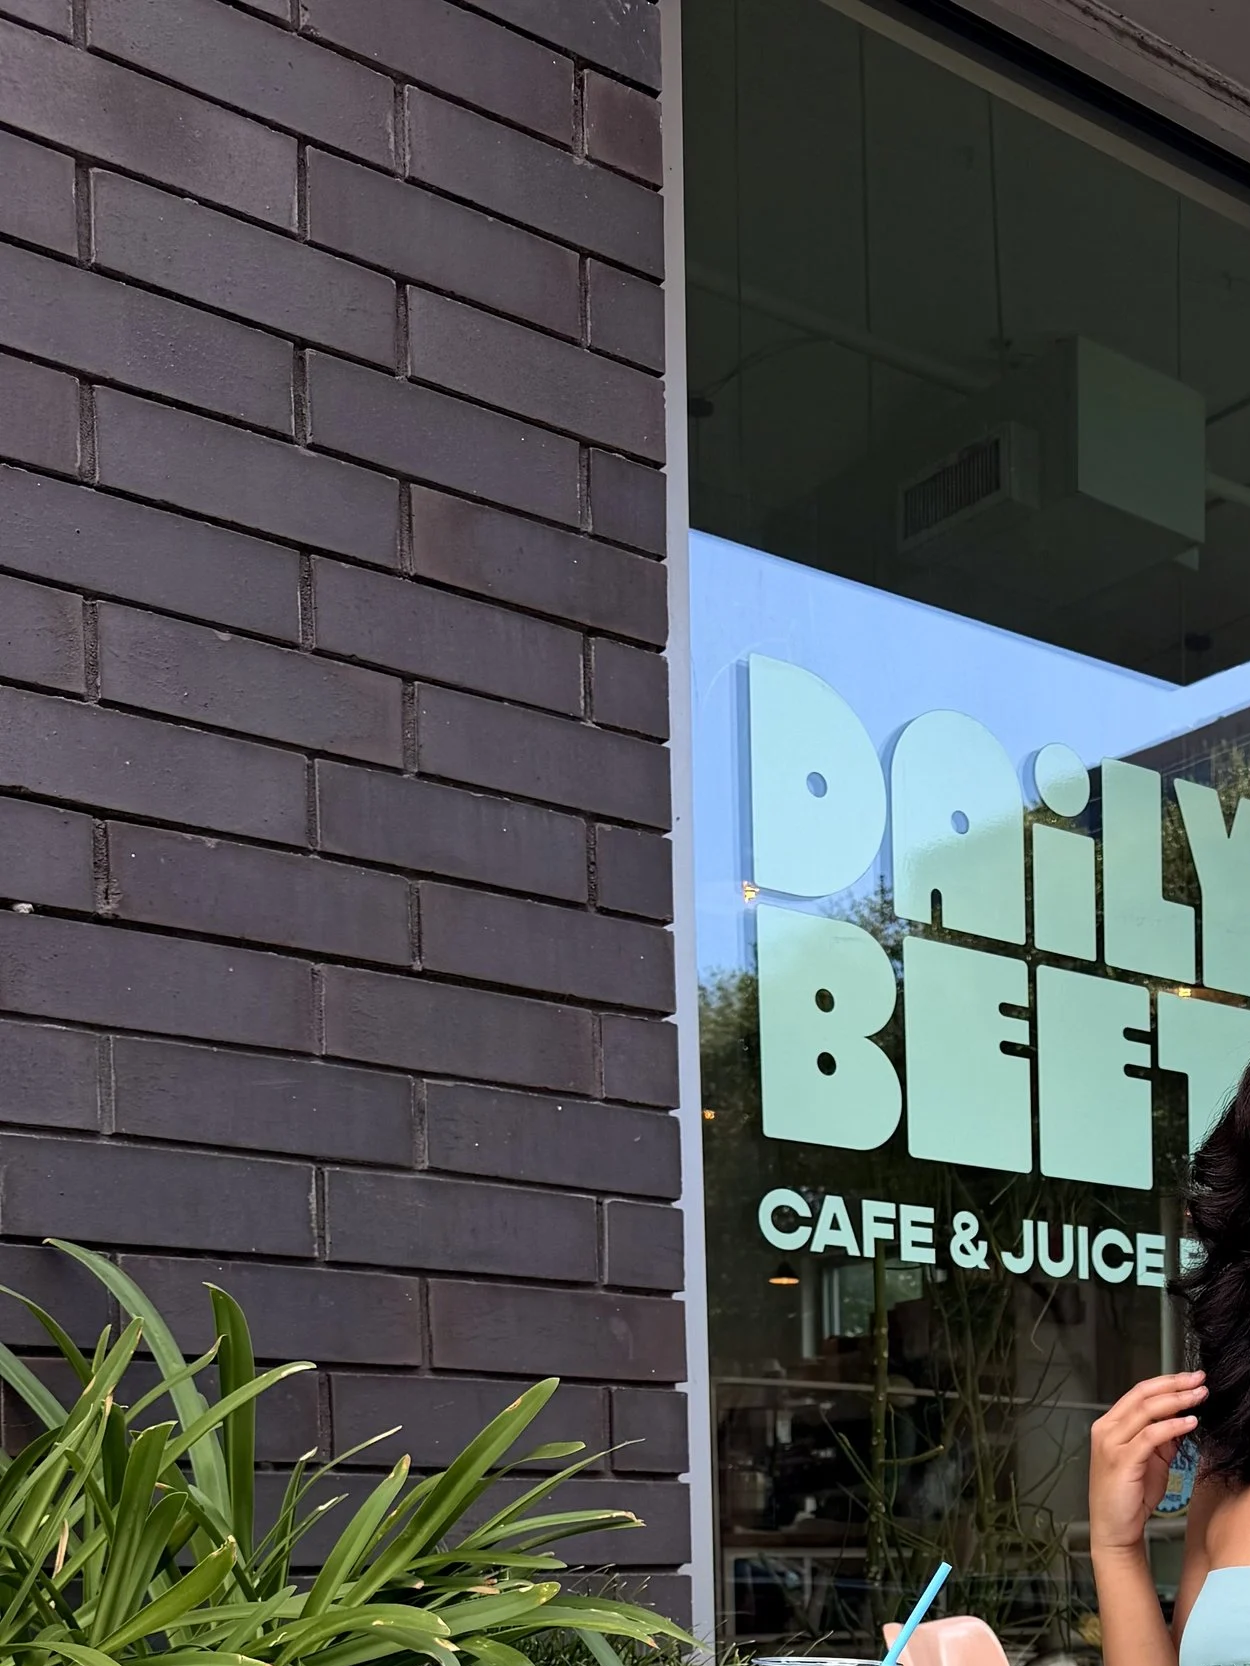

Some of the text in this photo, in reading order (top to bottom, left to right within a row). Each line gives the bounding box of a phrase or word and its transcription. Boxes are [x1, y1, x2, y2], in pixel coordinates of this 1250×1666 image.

[758, 1188, 937, 1265] CAFE
[949, 1210, 991, 1271] &
[1000, 1218, 1167, 1288] JUICE
